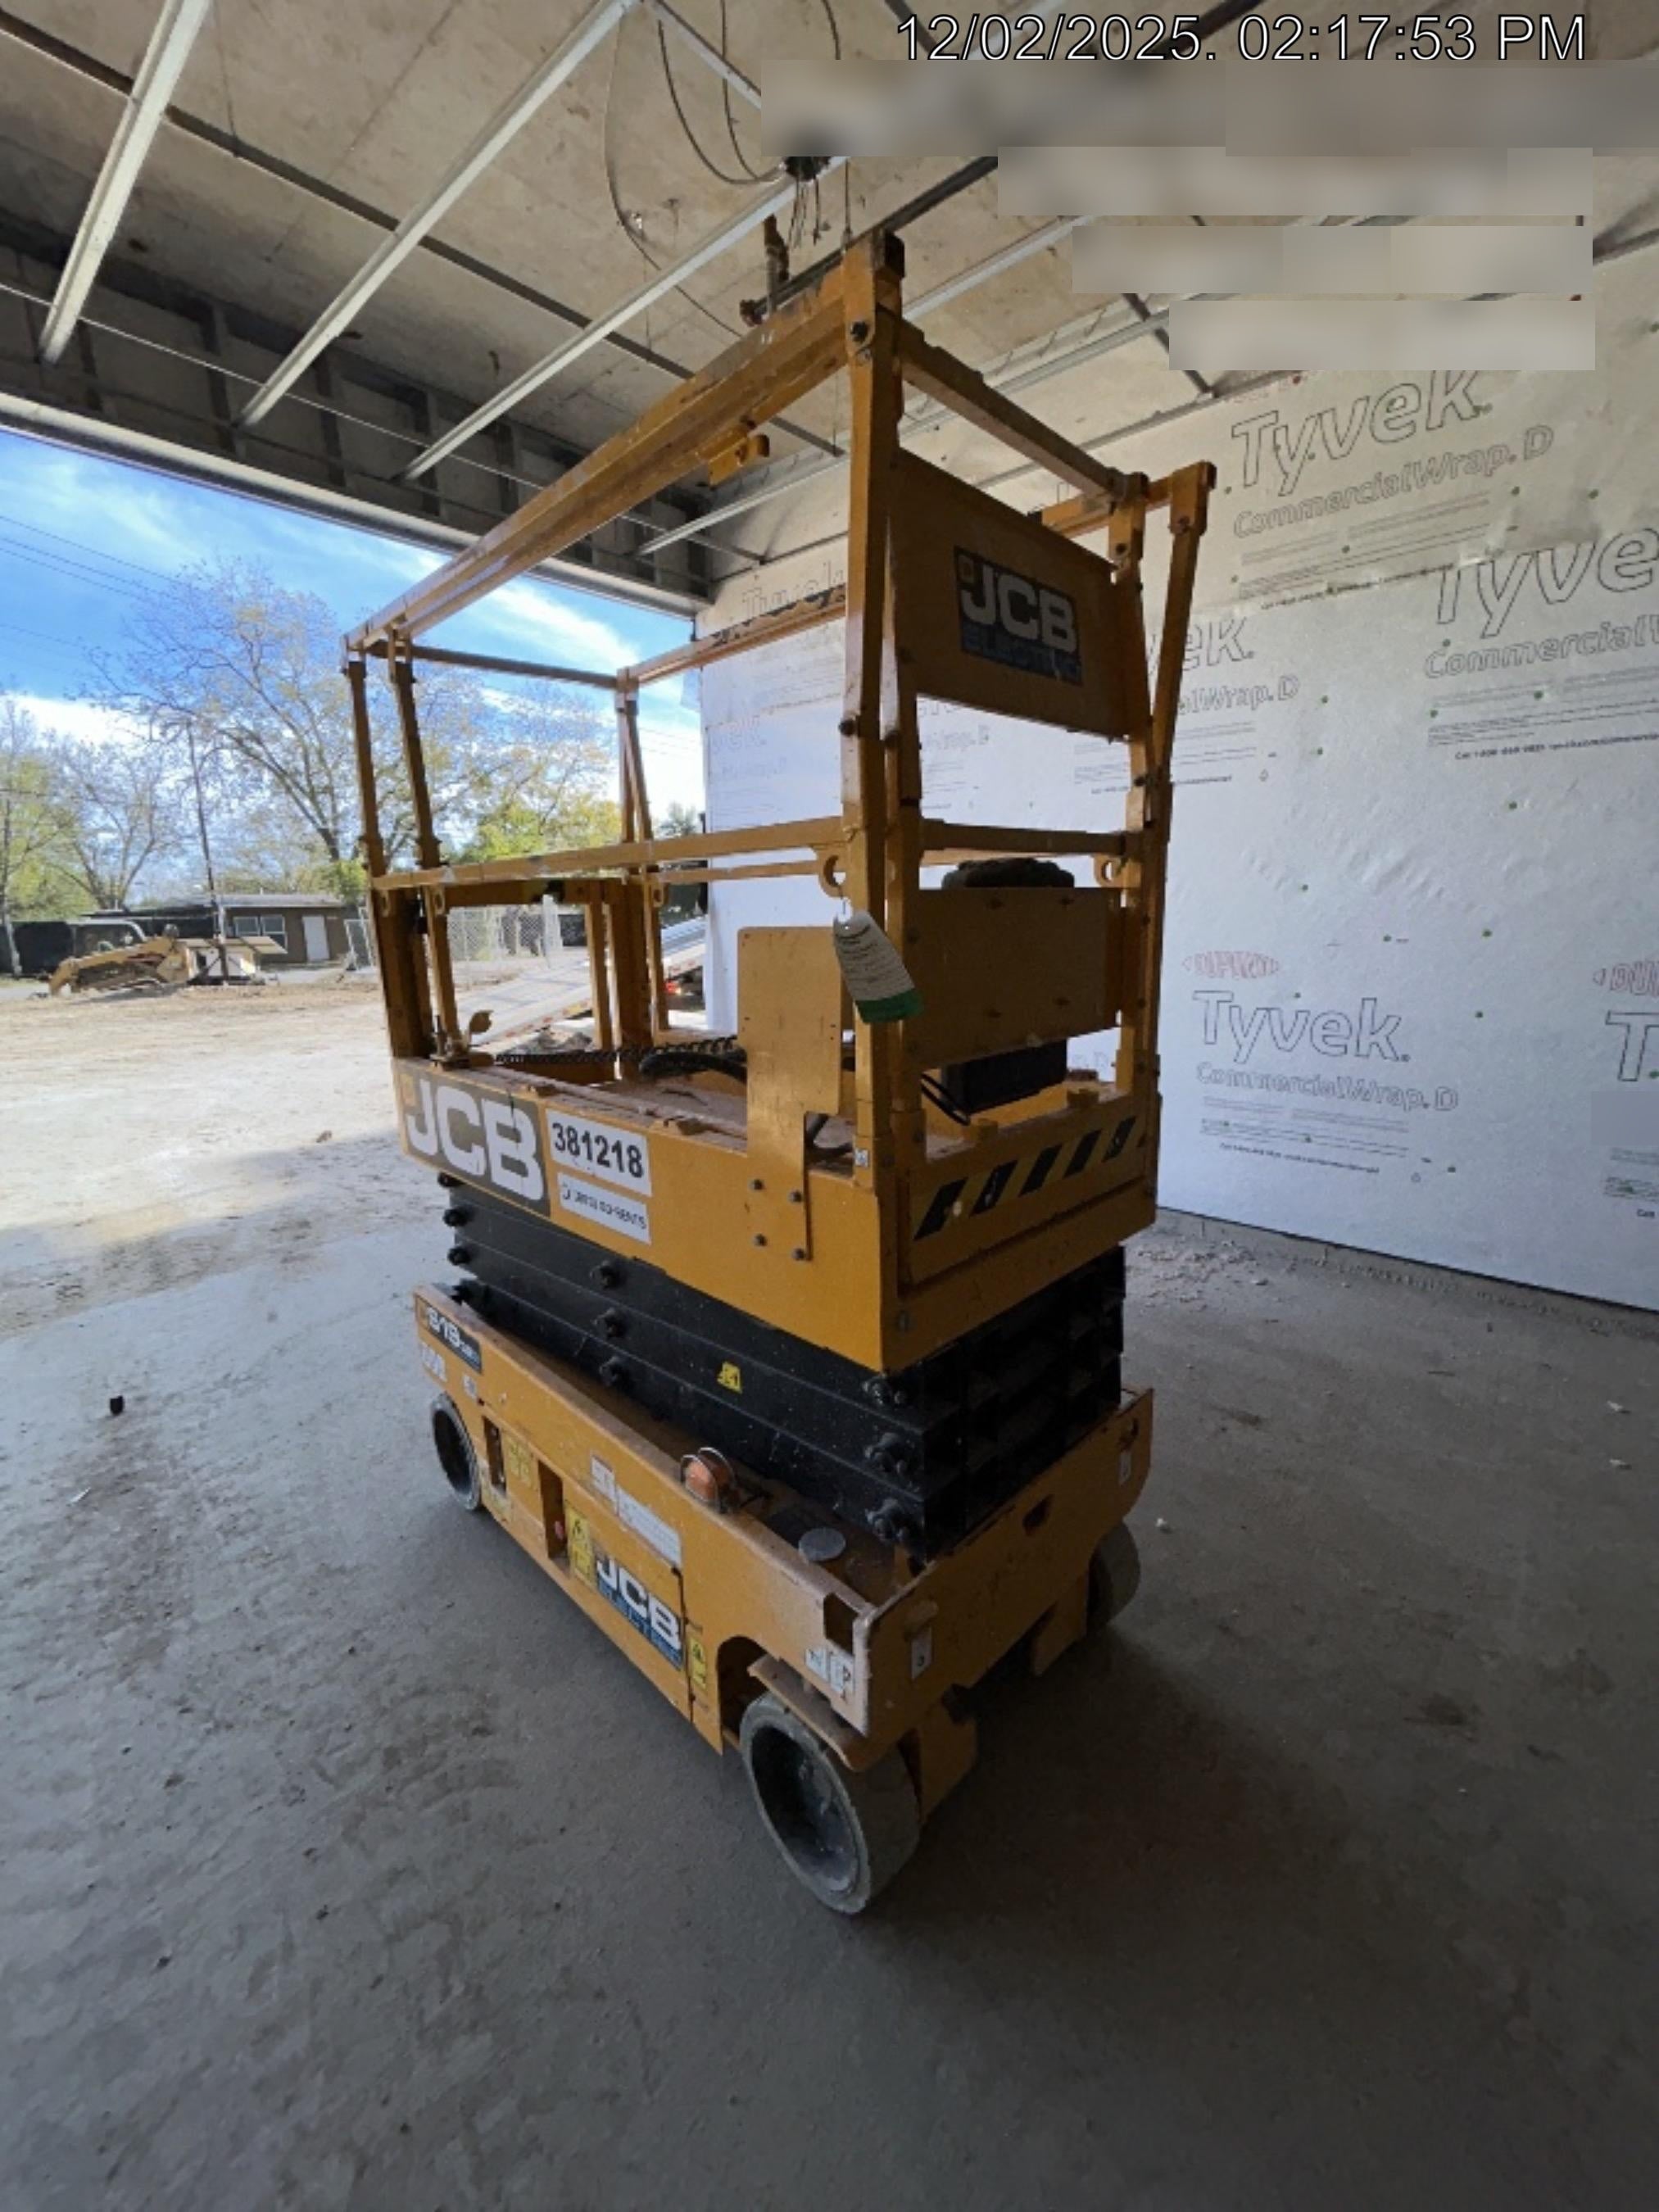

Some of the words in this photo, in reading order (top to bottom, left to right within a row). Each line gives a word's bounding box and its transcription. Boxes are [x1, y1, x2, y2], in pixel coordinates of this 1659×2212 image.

[960, 563, 1078, 654] JCB
[407, 1078, 545, 1201] JCB
[552, 1122, 644, 1179] 381218
[596, 1554, 682, 1650] JCB
